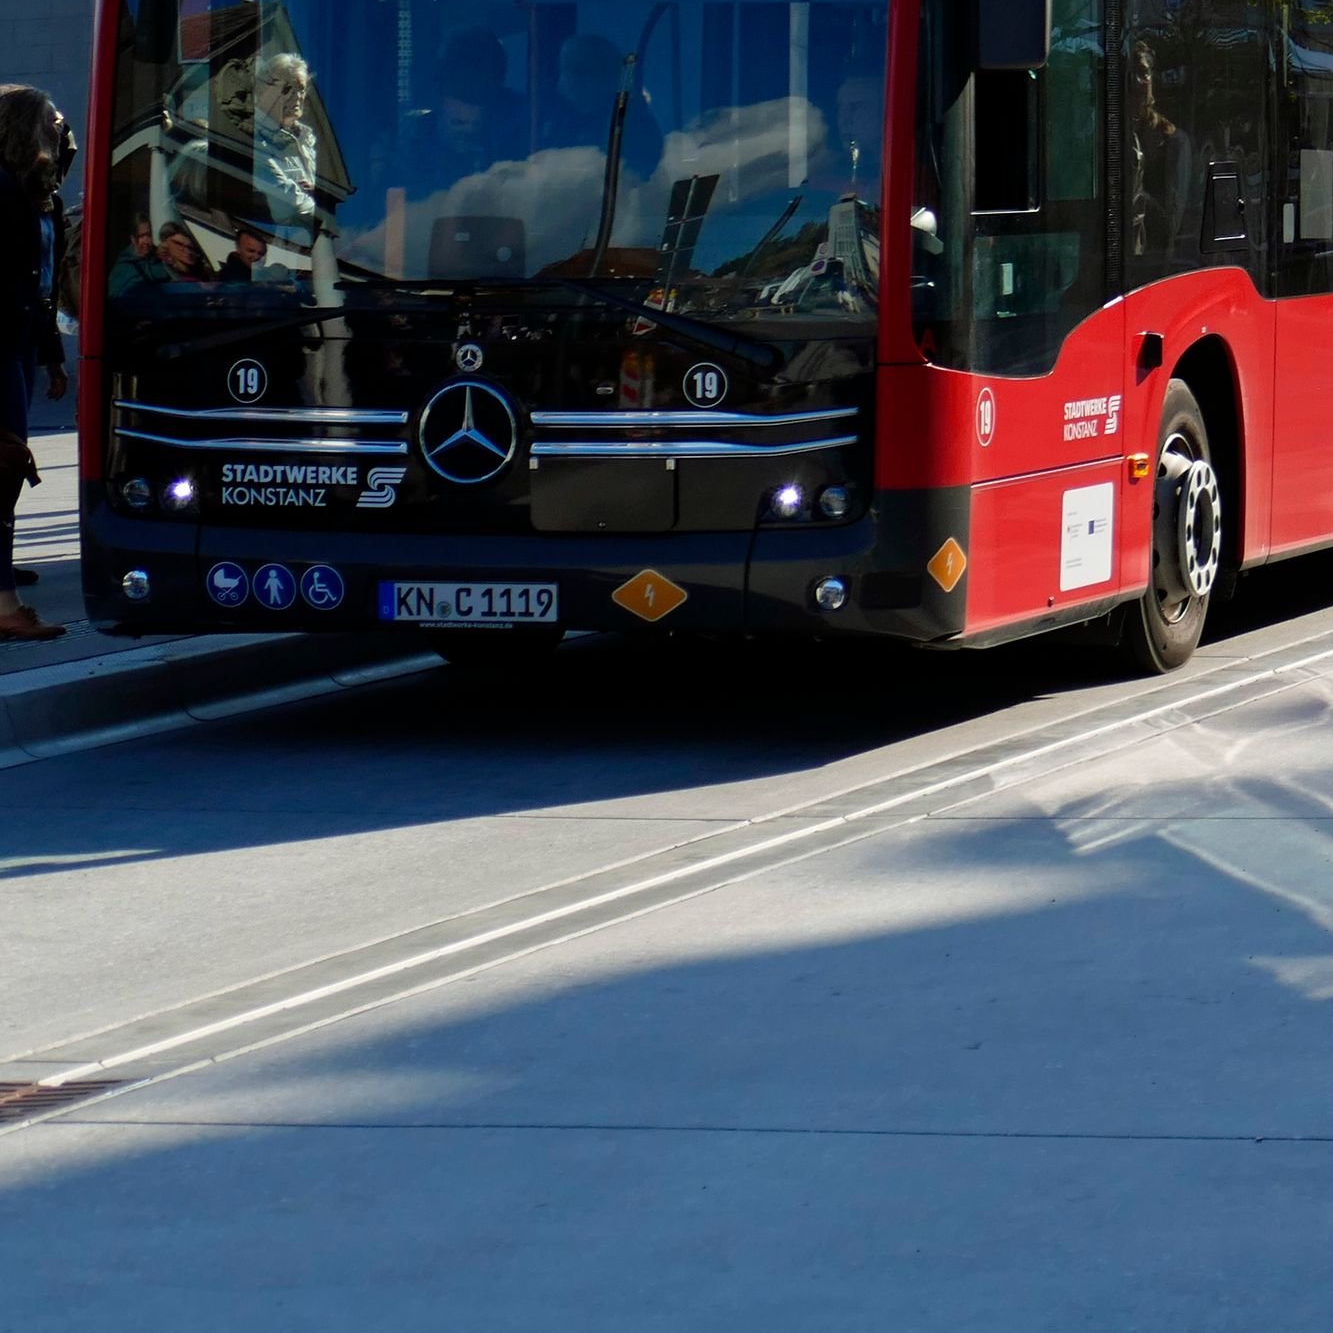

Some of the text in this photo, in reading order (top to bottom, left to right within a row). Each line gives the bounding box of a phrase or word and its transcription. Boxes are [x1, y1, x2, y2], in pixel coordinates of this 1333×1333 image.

[237, 368, 258, 394] 19
[693, 372, 717, 398] 19
[980, 400, 992, 435] 19
[1064, 397, 1107, 420] STADTWERKE
[1063, 419, 1098, 442] KONSTANZ
[221, 464, 358, 484] STADTWERKE
[221, 487, 326, 507] KONSTANZ
[396, 587, 434, 616] KN
[455, 587, 473, 616] C
[481, 587, 553, 617] 1119
